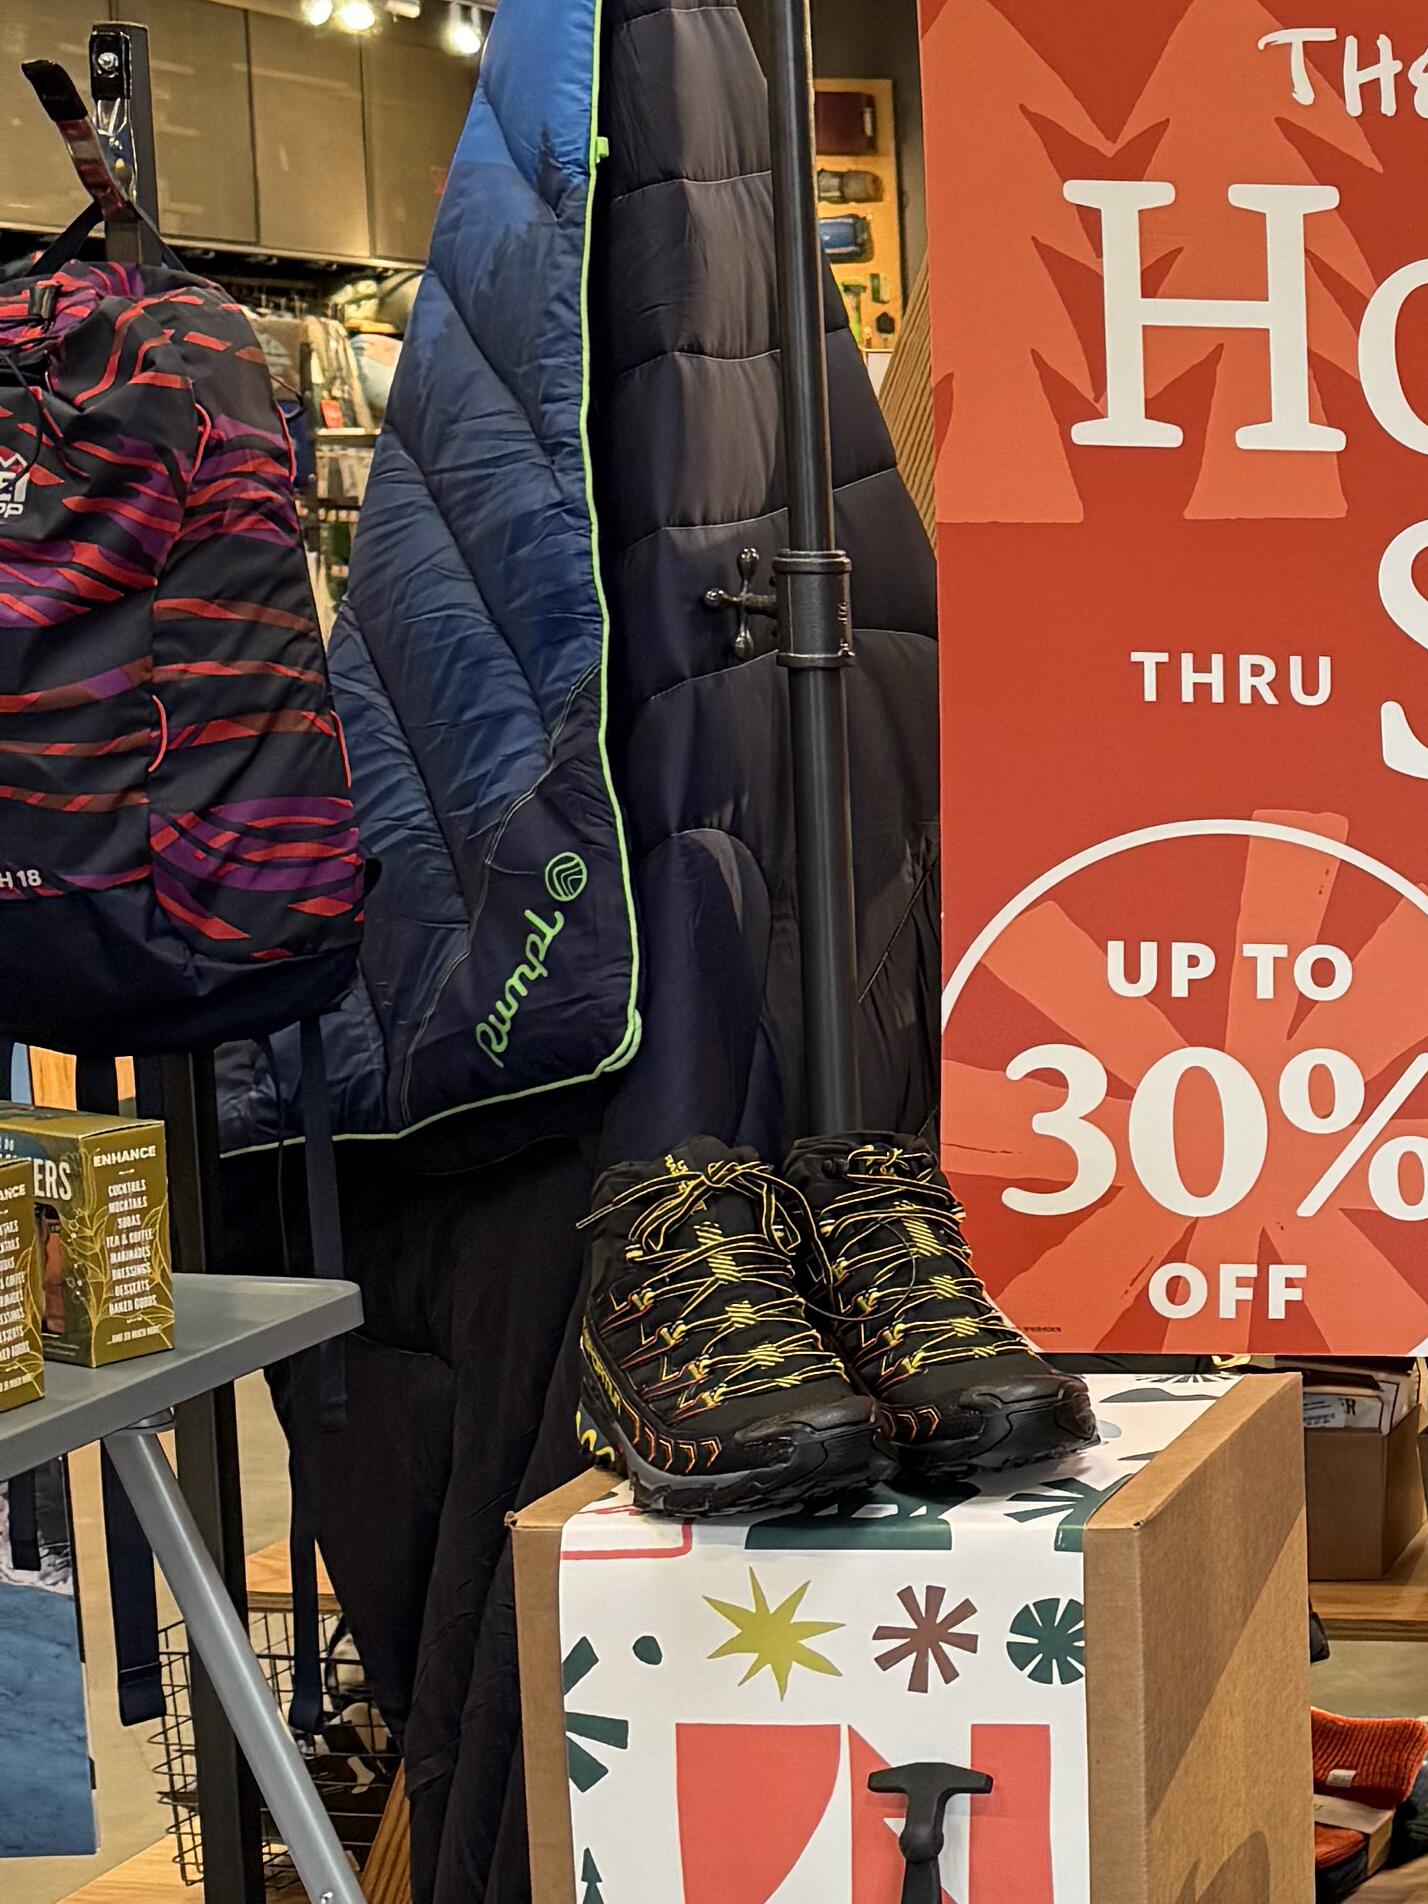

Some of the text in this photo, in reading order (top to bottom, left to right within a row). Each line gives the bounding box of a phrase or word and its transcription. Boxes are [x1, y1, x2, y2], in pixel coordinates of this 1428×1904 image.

[1130, 651, 1332, 706] THRU
[16, 869, 42, 888] 18
[1106, 940, 1353, 1002] UP TO
[93, 1145, 156, 1167] ENHANCE
[0, 1183, 26, 1200] ANCE
[1148, 1262, 1308, 1320] OFF
